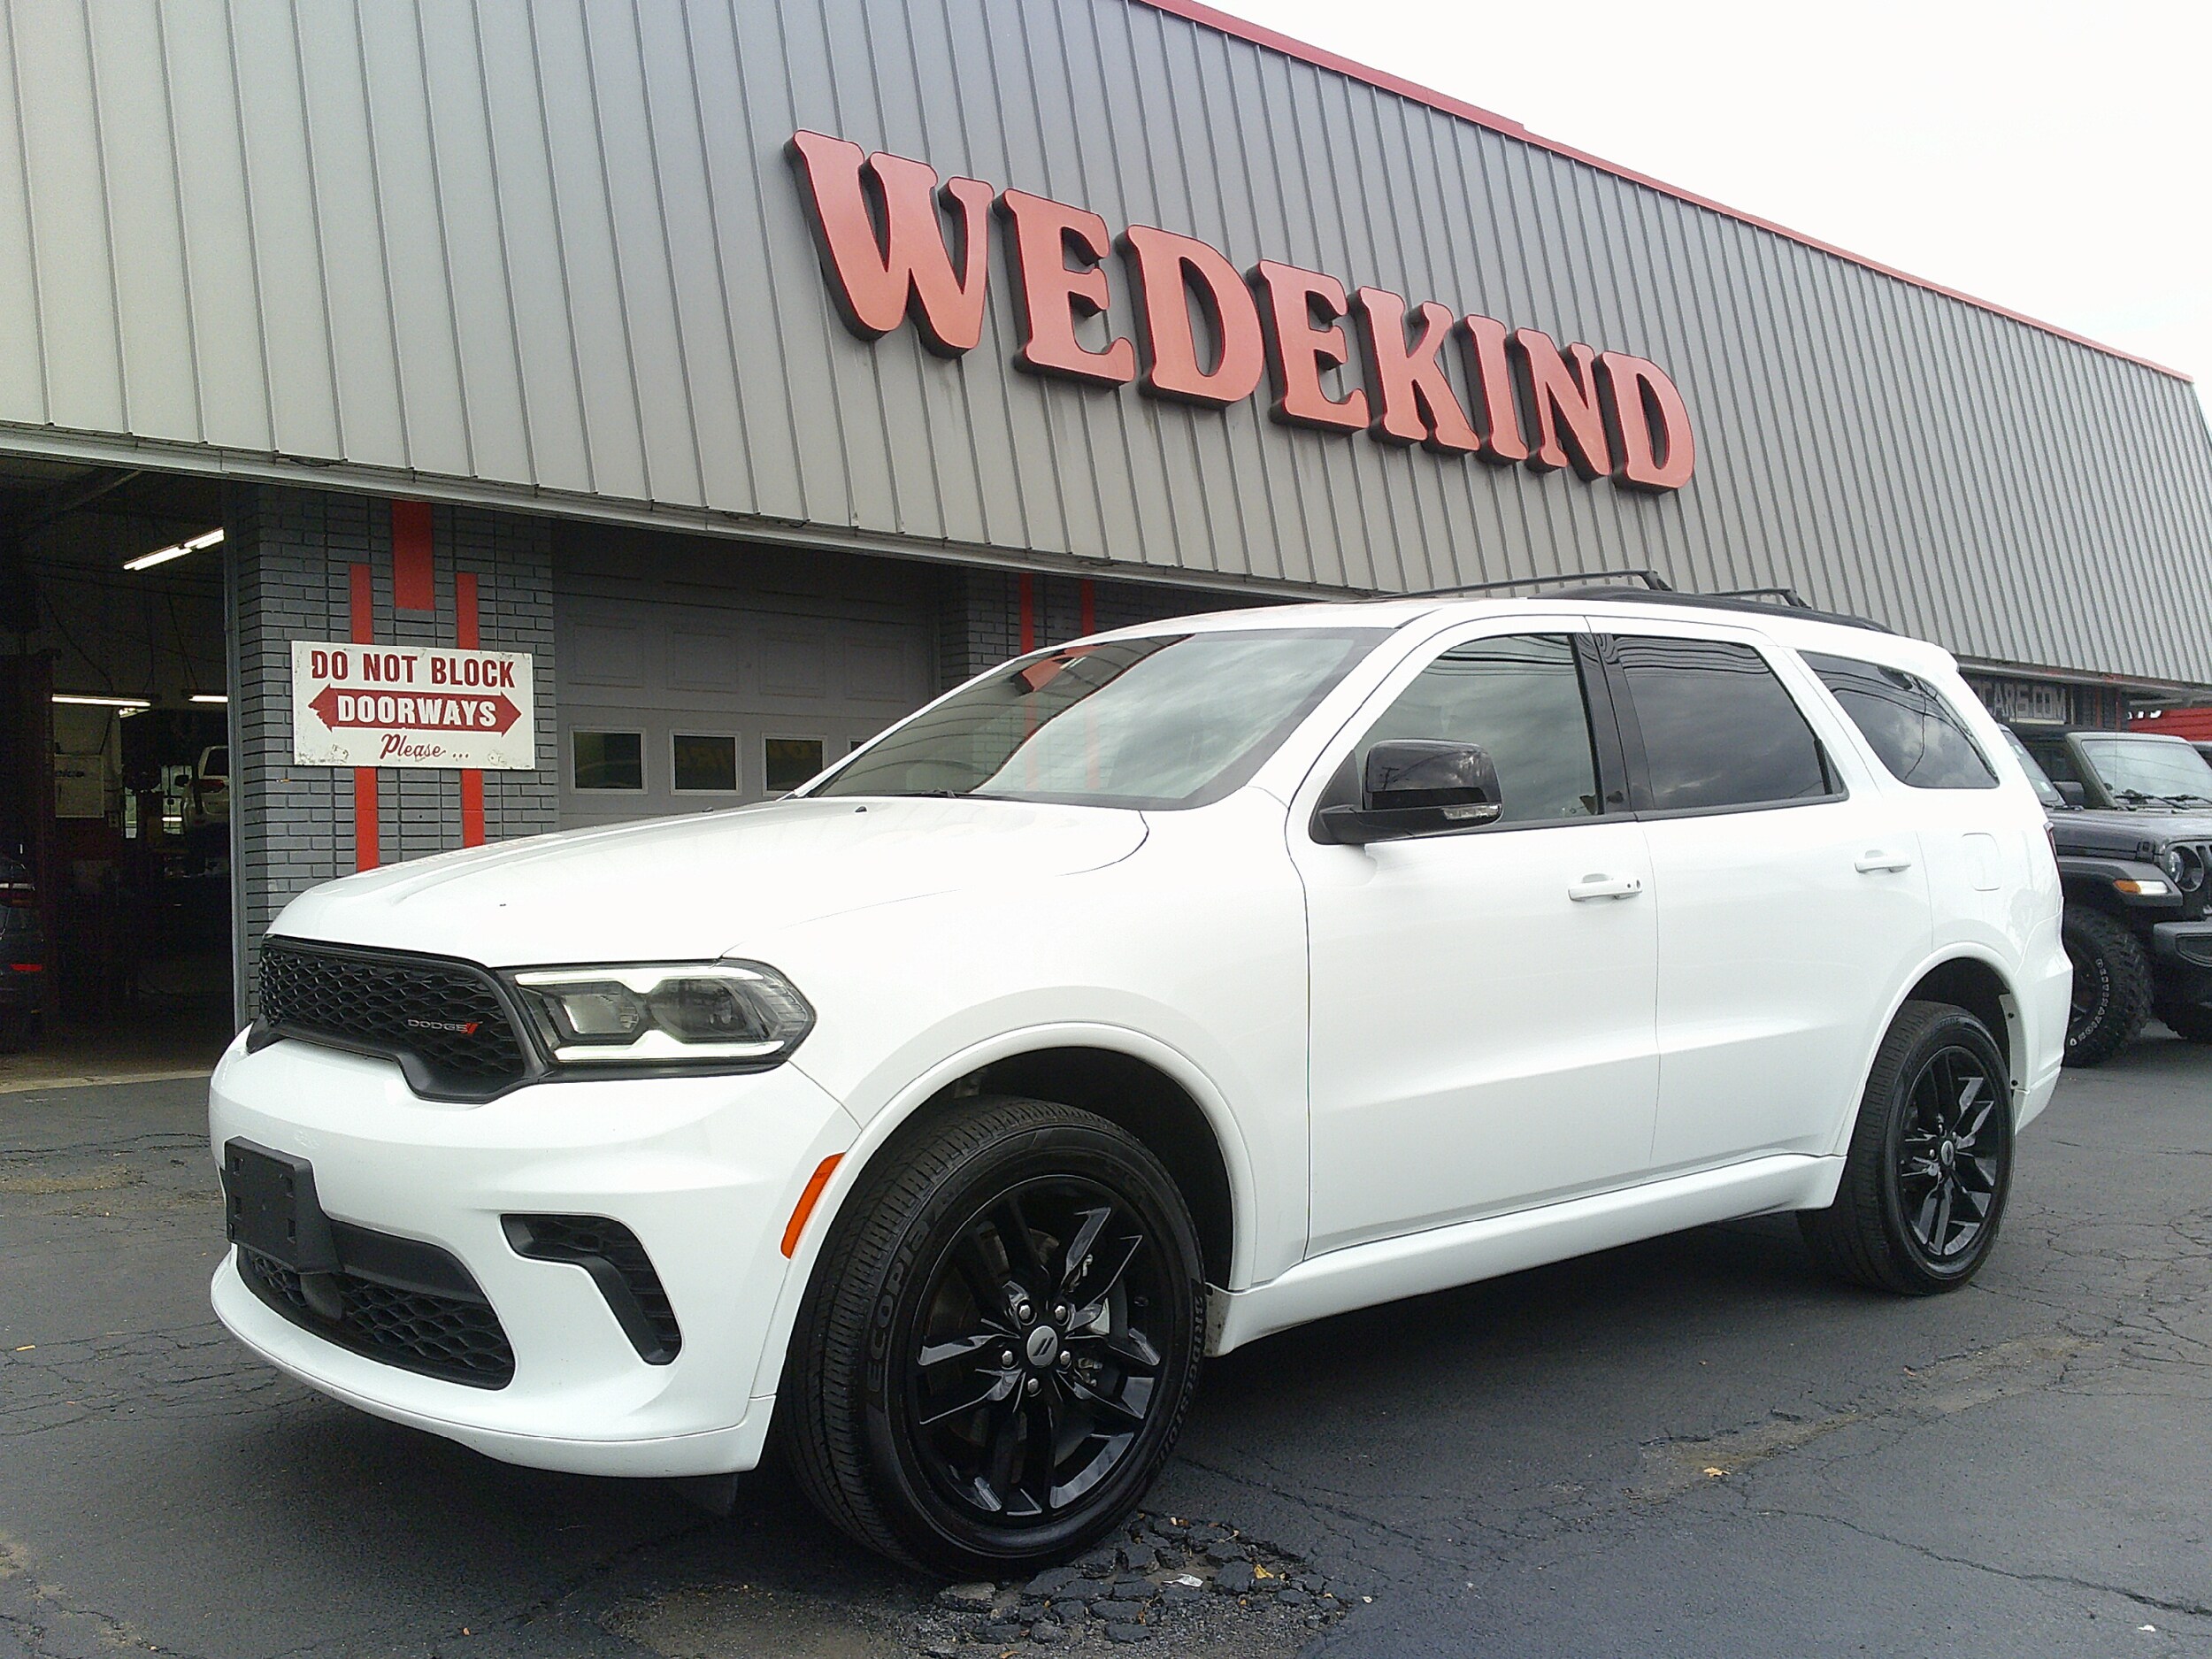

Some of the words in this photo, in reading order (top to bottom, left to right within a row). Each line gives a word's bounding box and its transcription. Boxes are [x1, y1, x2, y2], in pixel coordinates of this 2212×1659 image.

[787, 130, 1694, 491] WEDEKIND
[311, 650, 349, 680] DO
[363, 653, 418, 683] NOT
[431, 657, 515, 688] BLOCK
[337, 694, 496, 727] DOORWAYS
[379, 733, 446, 760] Please
[407, 1018, 468, 1033] DODGE
